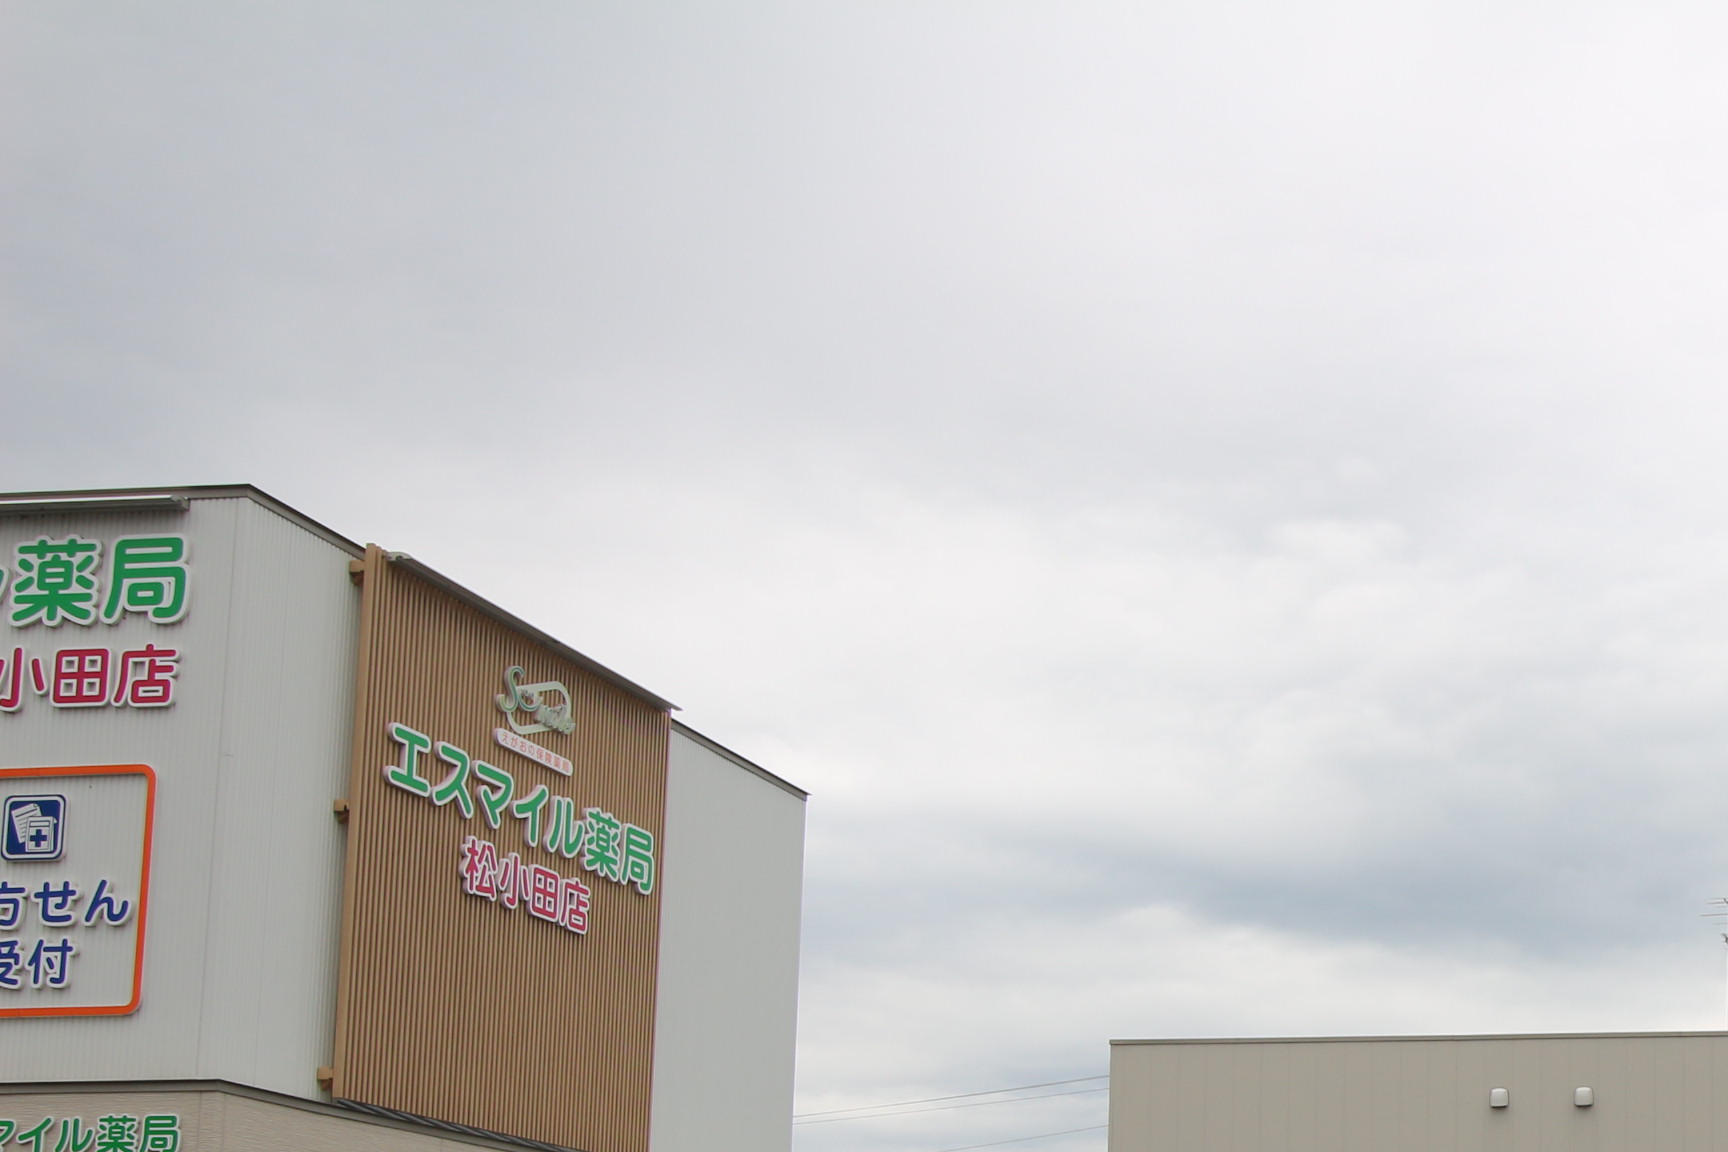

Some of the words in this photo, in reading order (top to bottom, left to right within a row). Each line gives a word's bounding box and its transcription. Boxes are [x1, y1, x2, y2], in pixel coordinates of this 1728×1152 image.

[0, 537, 187, 624] 薬局
[0, 643, 178, 709] 小田店
[388, 724, 653, 894] エスマイル薬局
[463, 837, 590, 934] 松小田店
